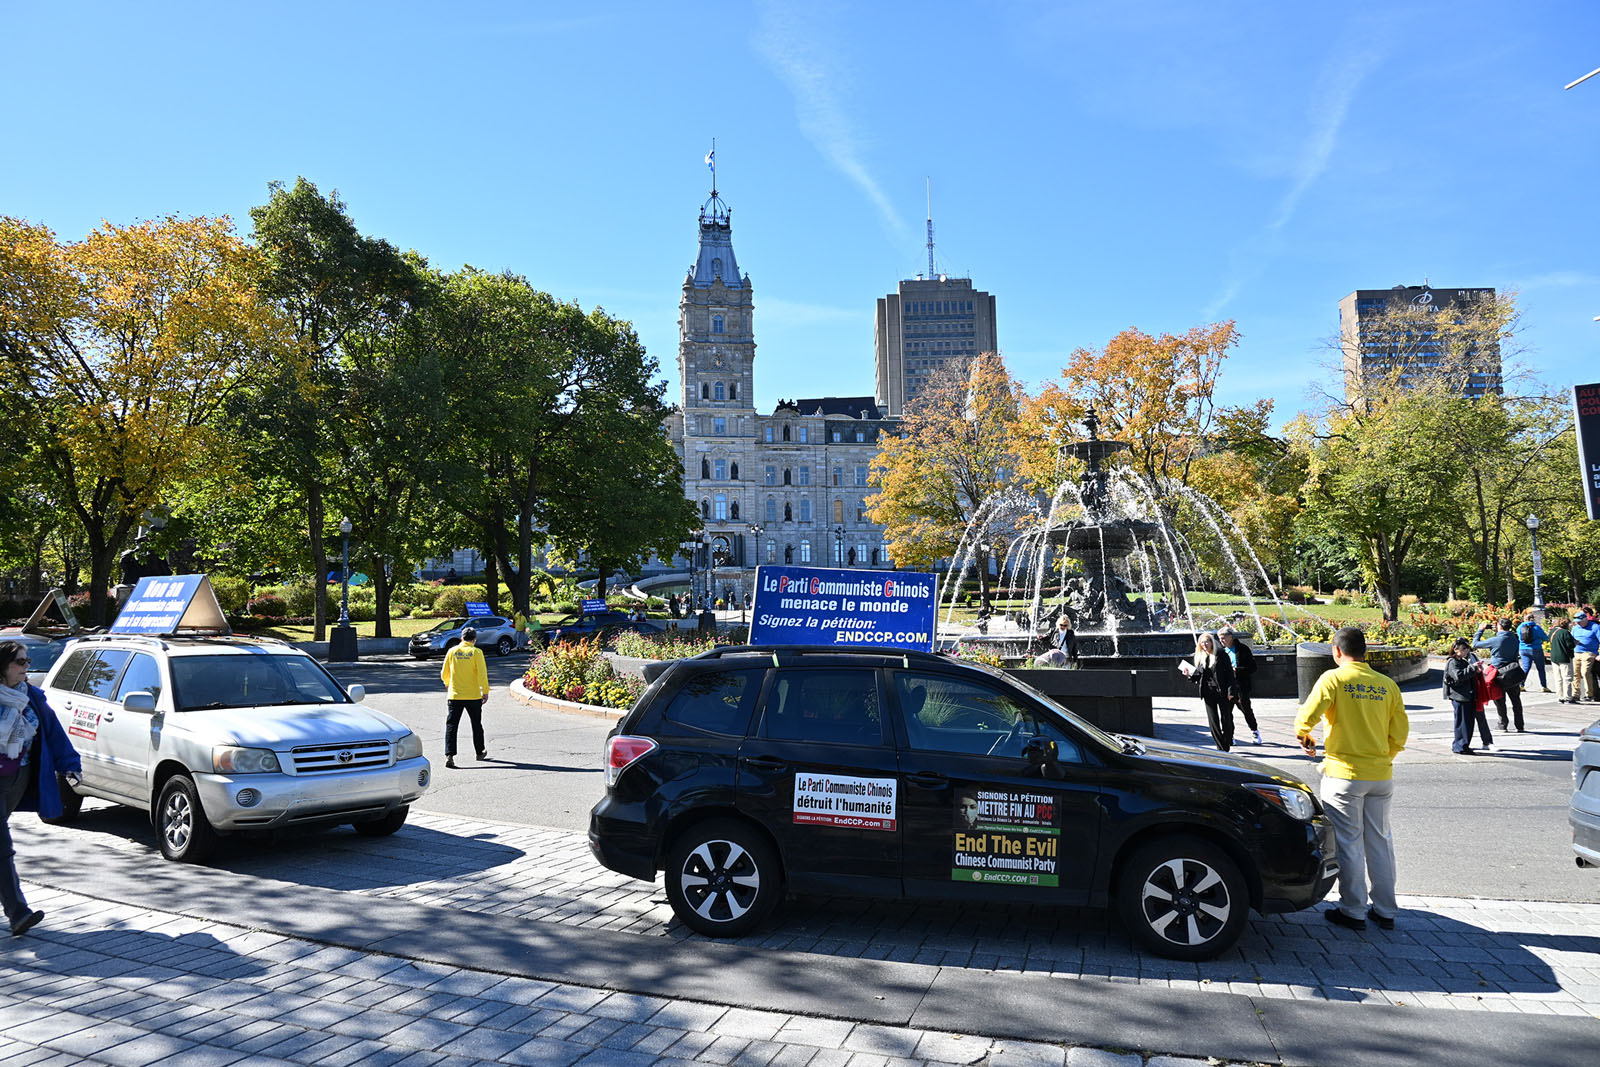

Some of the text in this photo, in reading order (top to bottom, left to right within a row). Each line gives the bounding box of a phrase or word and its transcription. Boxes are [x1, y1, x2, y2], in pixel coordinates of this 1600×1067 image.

[142, 580, 185, 598] Non au
[764, 576, 930, 598] Le Parti Communiste Chinois
[780, 598, 909, 613] menace le monde
[758, 614, 877, 630] Signez la pétition:
[836, 631, 928, 644] ENDCCP.COM
[1343, 684, 1388, 696] 法輪大法
[798, 777, 893, 798] Le Parti Communiste Chinois
[797, 795, 892, 815] détruit l'humanité
[977, 791, 1054, 804] SIGNONS LA PÉTITION
[977, 800, 1053, 820] METTRE FIN AU PCC
[834, 817, 881, 827] EndCCP.com
[955, 833, 1057, 857] End The Evil
[955, 852, 1056, 874] Chinese Communist Party
[984, 874, 1028, 883] EndCCP.COM
